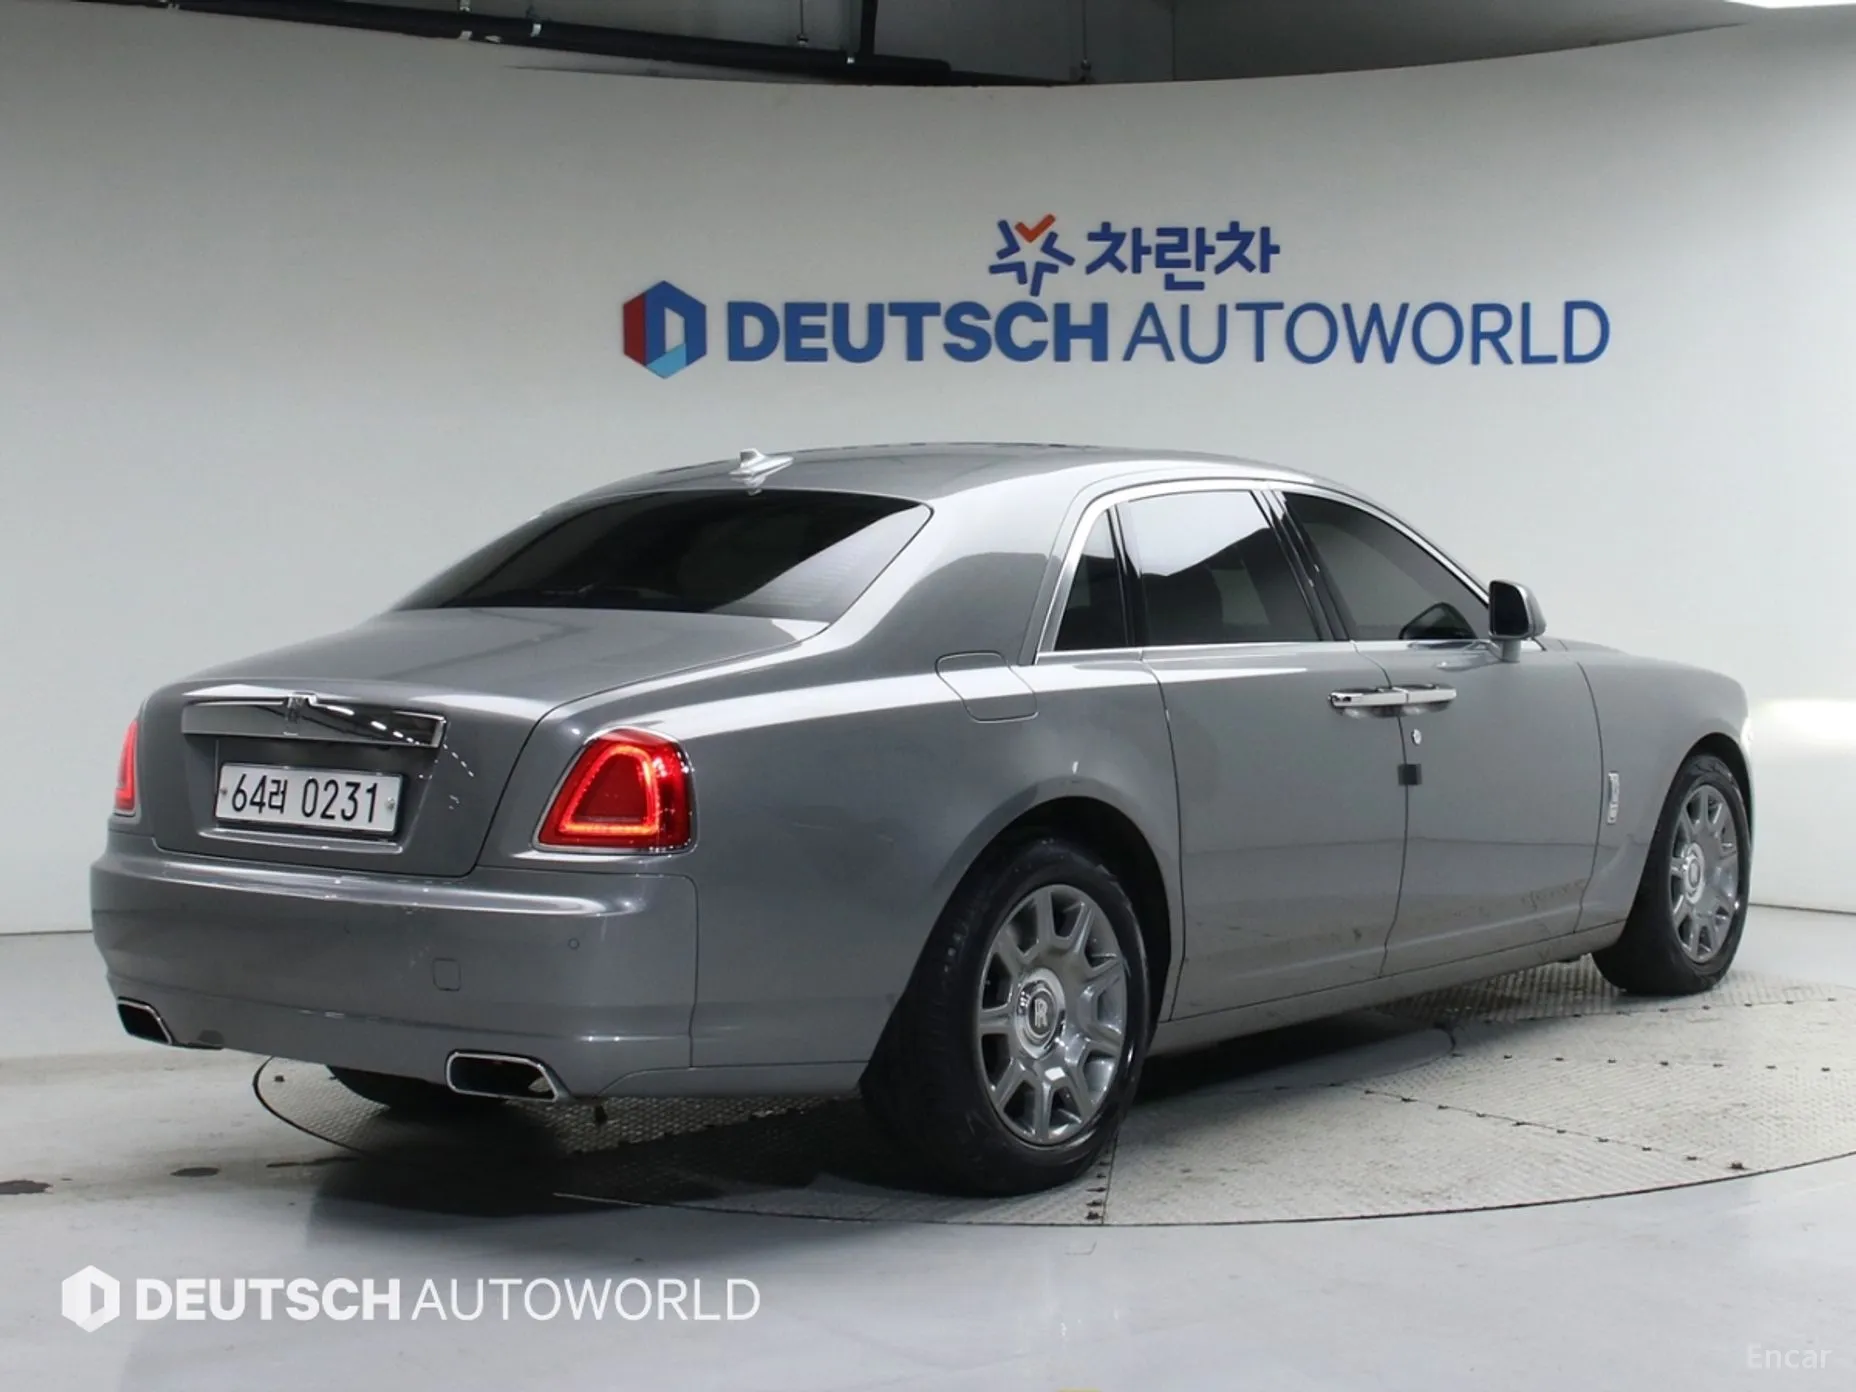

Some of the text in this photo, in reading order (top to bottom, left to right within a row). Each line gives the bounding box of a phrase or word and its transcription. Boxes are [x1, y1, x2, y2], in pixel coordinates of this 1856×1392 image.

[1086, 221, 1281, 292] 차란차
[726, 298, 1613, 367] DEUTSCH AUTOWORLD
[231, 773, 379, 824] 64러 0231
